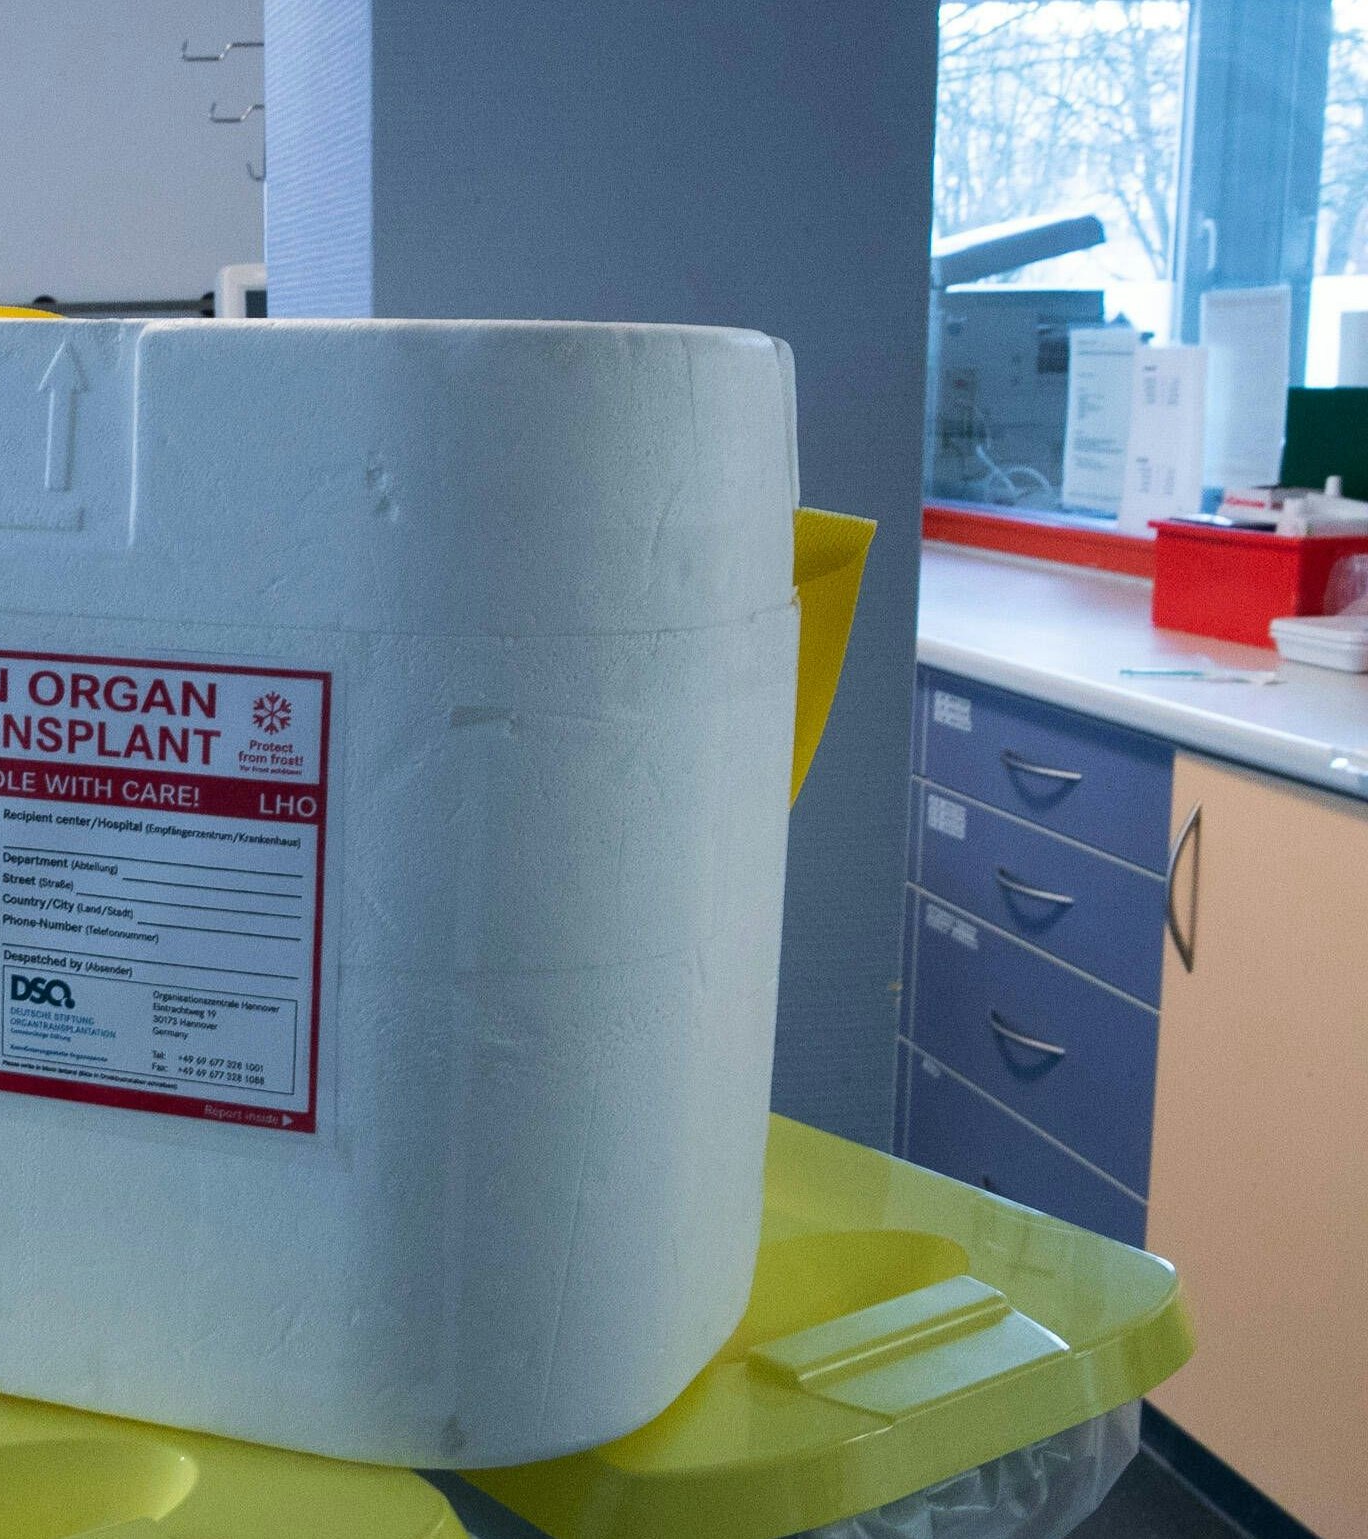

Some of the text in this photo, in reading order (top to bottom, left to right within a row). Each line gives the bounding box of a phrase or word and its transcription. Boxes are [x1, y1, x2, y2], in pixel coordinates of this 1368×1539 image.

[28, 670, 217, 718] ORGAN
[249, 740, 293, 753] Protect
[239, 751, 303, 767] from frost!
[45, 773, 112, 798] WITH
[122, 781, 200, 807] CARE!
[259, 794, 317, 818] LHO
[3, 808, 53, 824] Recipient
[55, 815, 142, 833] center/Hospital
[3, 852, 118, 876] Department (Abteilung)
[2, 872, 74, 891] Street (Straße)
[2, 893, 74, 913] Country/City
[2, 914, 159, 944] Phone-Number (Telefonnummer)
[3, 950, 133, 979] Despatched by (Absender)
[152, 990, 280, 1014] Organisationszentrale Hannover
[152, 1002, 217, 1020] Eintrachtweg 19
[10, 1007, 94, 1026] DEUTSCHE STIFTUNG
[152, 1014, 217, 1030] 30173 Hannover
[9, 1018, 116, 1039] ORGANTRANSPLANTATION
[152, 1027, 189, 1040] Germany
[196, 1056, 207, 1065] 69
[209, 1058, 224, 1067] 677
[226, 1059, 242, 1070] 328
[196, 1069, 207, 1078] 69
[209, 1070, 224, 1080] 677
[226, 1072, 243, 1082] 328
[204, 1104, 279, 1125] Report inside
